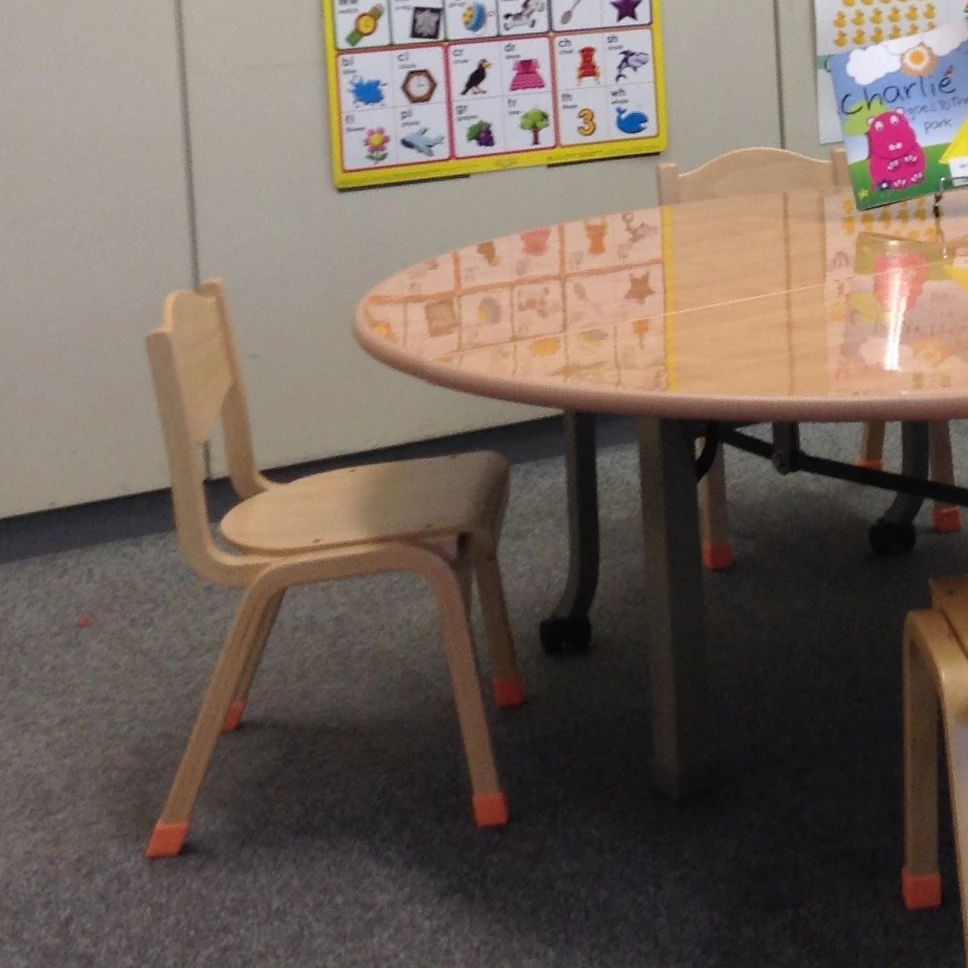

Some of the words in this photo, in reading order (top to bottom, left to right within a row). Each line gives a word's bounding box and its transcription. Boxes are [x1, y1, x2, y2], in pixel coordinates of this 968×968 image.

[558, 38, 572, 47] ch
[841, 75, 956, 114] Charlie
[924, 118, 952, 133] park
